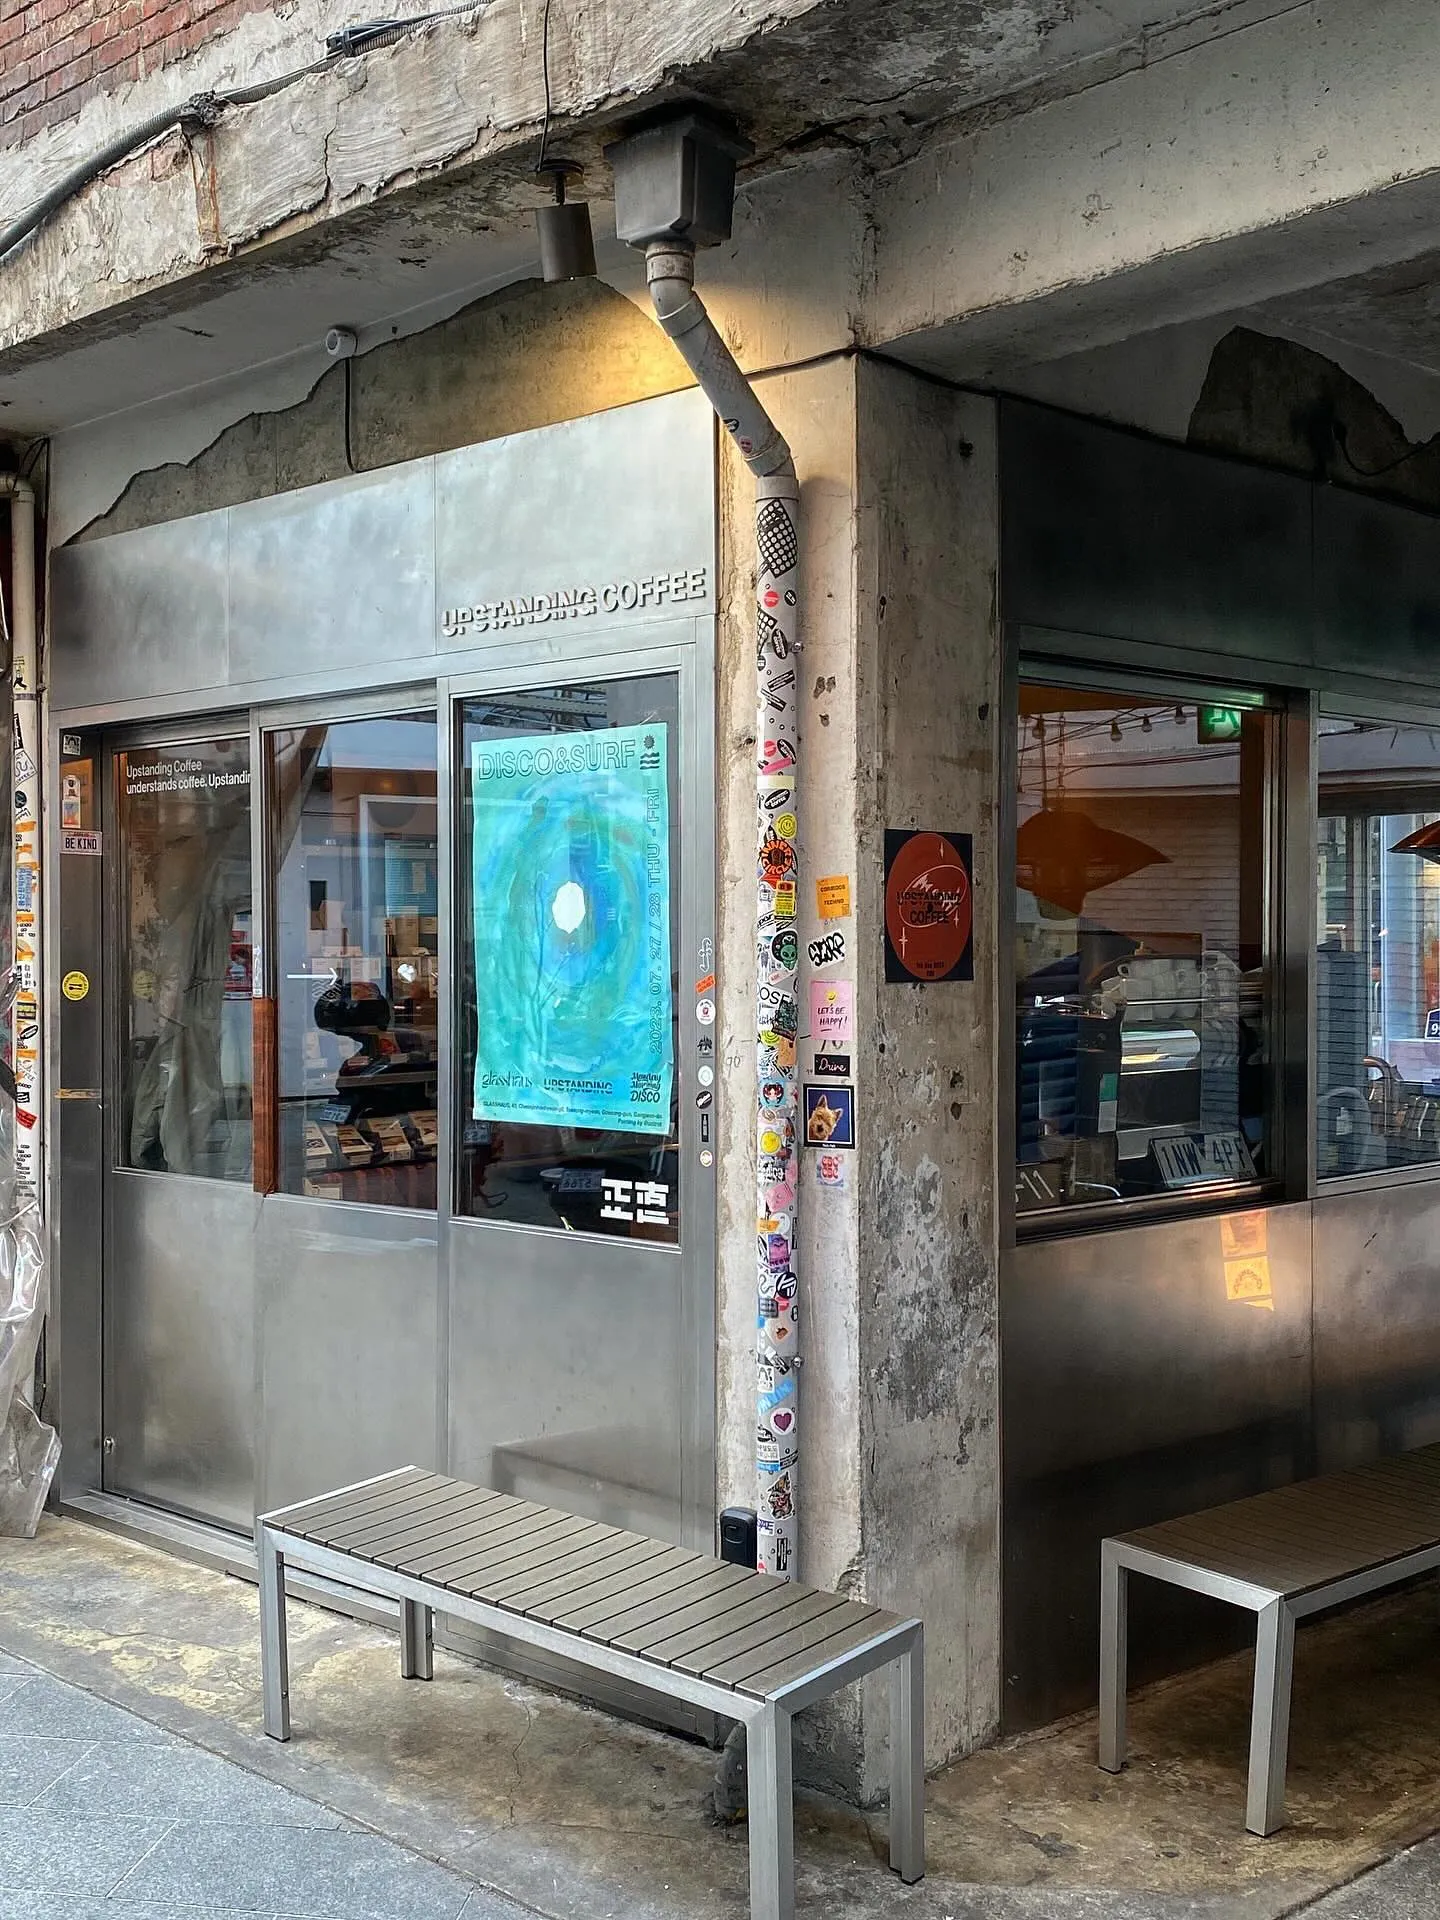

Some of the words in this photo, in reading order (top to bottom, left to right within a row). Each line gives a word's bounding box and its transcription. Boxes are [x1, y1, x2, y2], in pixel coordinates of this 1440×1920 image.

[441, 586, 598, 637] UPSTANDING
[602, 568, 706, 612] COFFEE
[126, 761, 173, 780] Upstanding
[173, 758, 202, 772] Coffee
[479, 740, 635, 780] DISCO&SURF
[126, 779, 177, 794] understands
[178, 775, 208, 790] coffee.
[647, 788, 660, 824] FRI
[65, 837, 75, 849] BE
[77, 838, 97, 850] KIND
[648, 843, 661, 888] THU
[649, 892, 661, 918] 28
[909, 911, 950, 924] COFFEE
[650, 936, 662, 960] 27
[650, 966, 662, 995] 07.
[835, 1007, 846, 1015] BE
[650, 1001, 662, 1054] 2023.
[543, 1078, 613, 1095] UPSTANDING
[630, 1090, 661, 1103] DISCO
